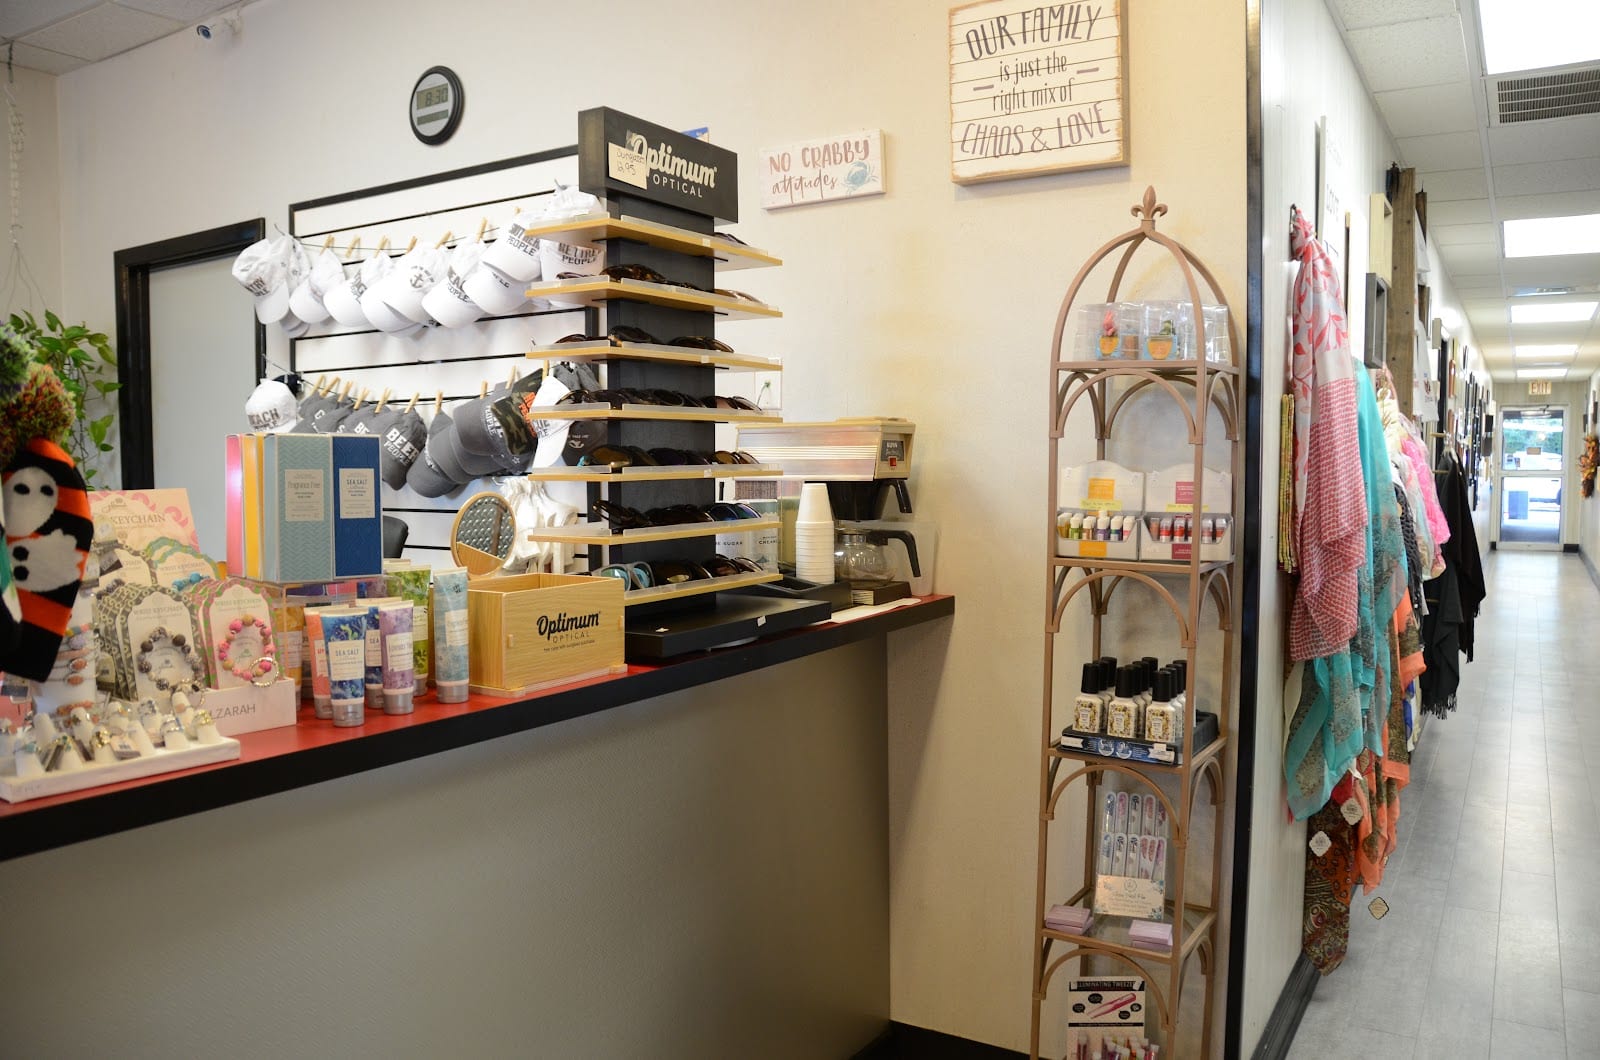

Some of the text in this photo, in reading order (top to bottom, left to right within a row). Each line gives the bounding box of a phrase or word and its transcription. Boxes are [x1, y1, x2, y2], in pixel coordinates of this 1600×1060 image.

[966, 5, 1102, 60] OUR FAMILY
[1000, 50, 1067, 85] is just the
[993, 77, 1076, 115] right mix of
[960, 101, 1110, 158] CHAOS & LOVE
[630, 134, 716, 188] Optimum
[769, 138, 870, 175] NO CRABBY
[653, 173, 703, 198] OPTICAL
[771, 167, 839, 204] attitudes
[1531, 382, 1549, 393] EXIT
[537, 611, 599, 641] Optimum
[552, 631, 590, 644] OPTICAL
[335, 648, 359, 657] SEA SALT
